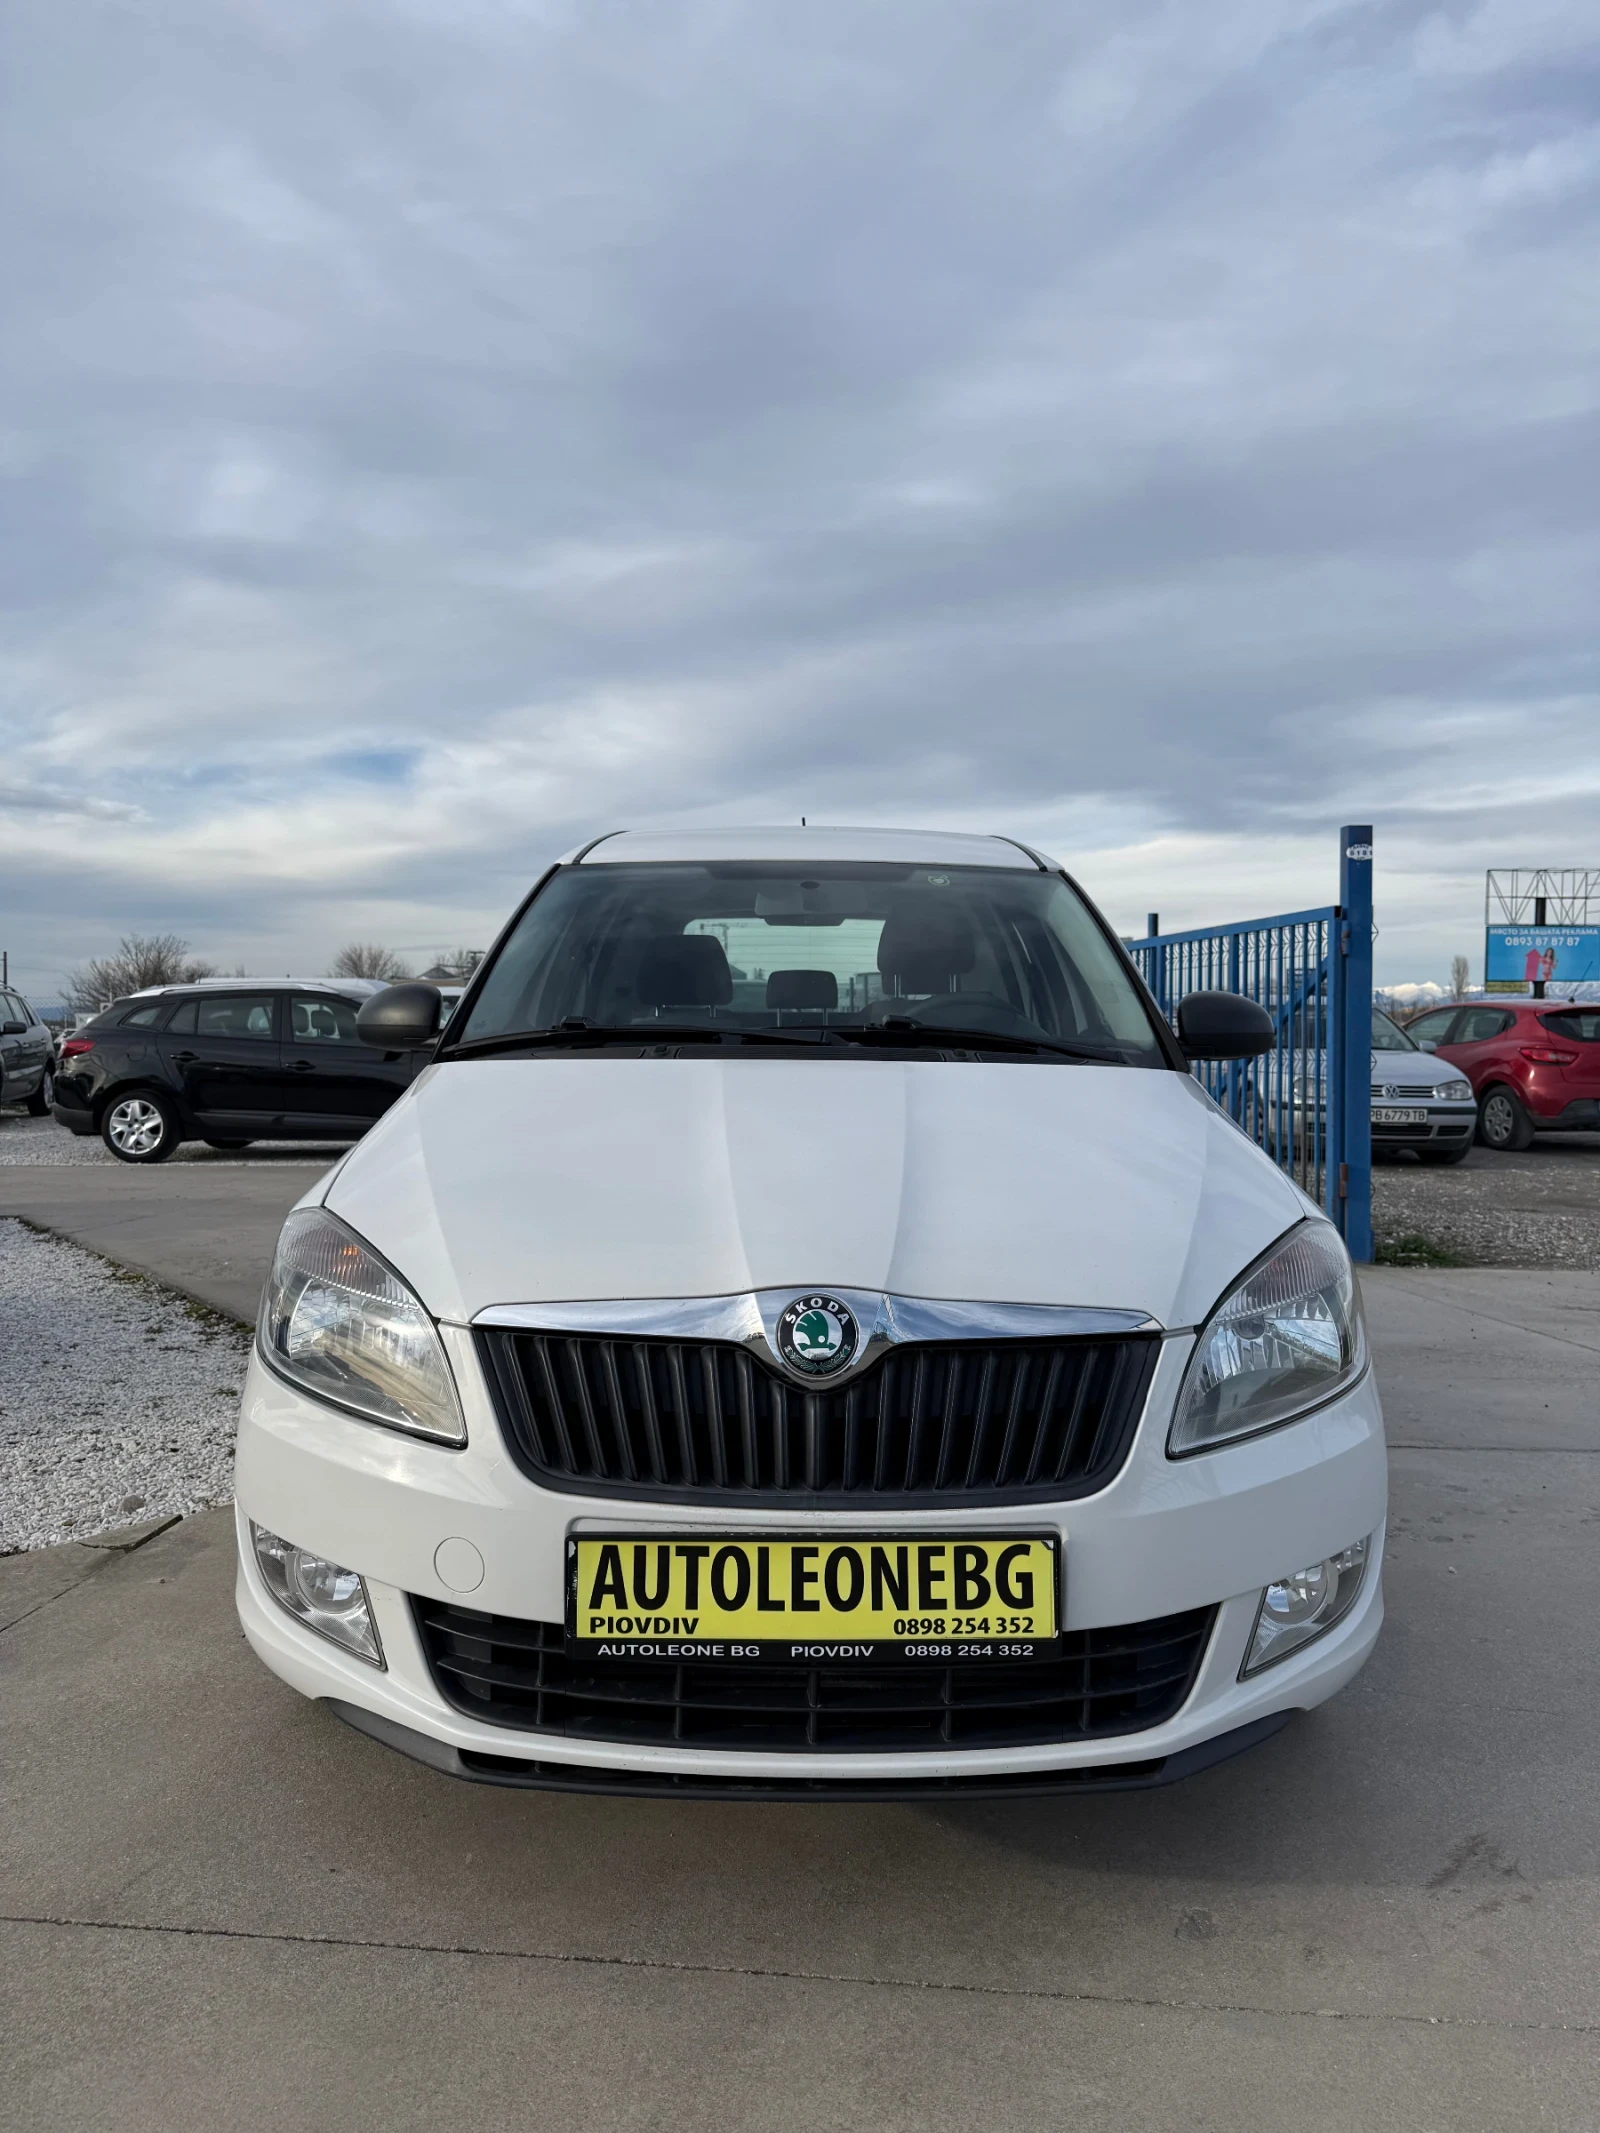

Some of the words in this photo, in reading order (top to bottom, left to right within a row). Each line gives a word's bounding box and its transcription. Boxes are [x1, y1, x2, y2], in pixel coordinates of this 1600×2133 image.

[1505, 936, 1533, 946] 0893
[1535, 936, 1549, 946] 87
[1551, 936, 1564, 946] 87
[1566, 936, 1580, 946] 87
[1384, 1110, 1410, 1121] 6779
[1412, 1110, 1425, 1121] TB
[588, 1543, 1034, 1612] AUTOLEONEBG
[893, 1618, 946, 1635] 0898
[951, 1617, 990, 1634] 254
[996, 1616, 1034, 1634] 352
[597, 1645, 725, 1656] AUTOLEONE
[730, 1645, 760, 1657] BG
[791, 1645, 874, 1657] PIOVDIV
[904, 1645, 952, 1656] 0898
[957, 1645, 993, 1656] 254
[998, 1645, 1034, 1656] 352
